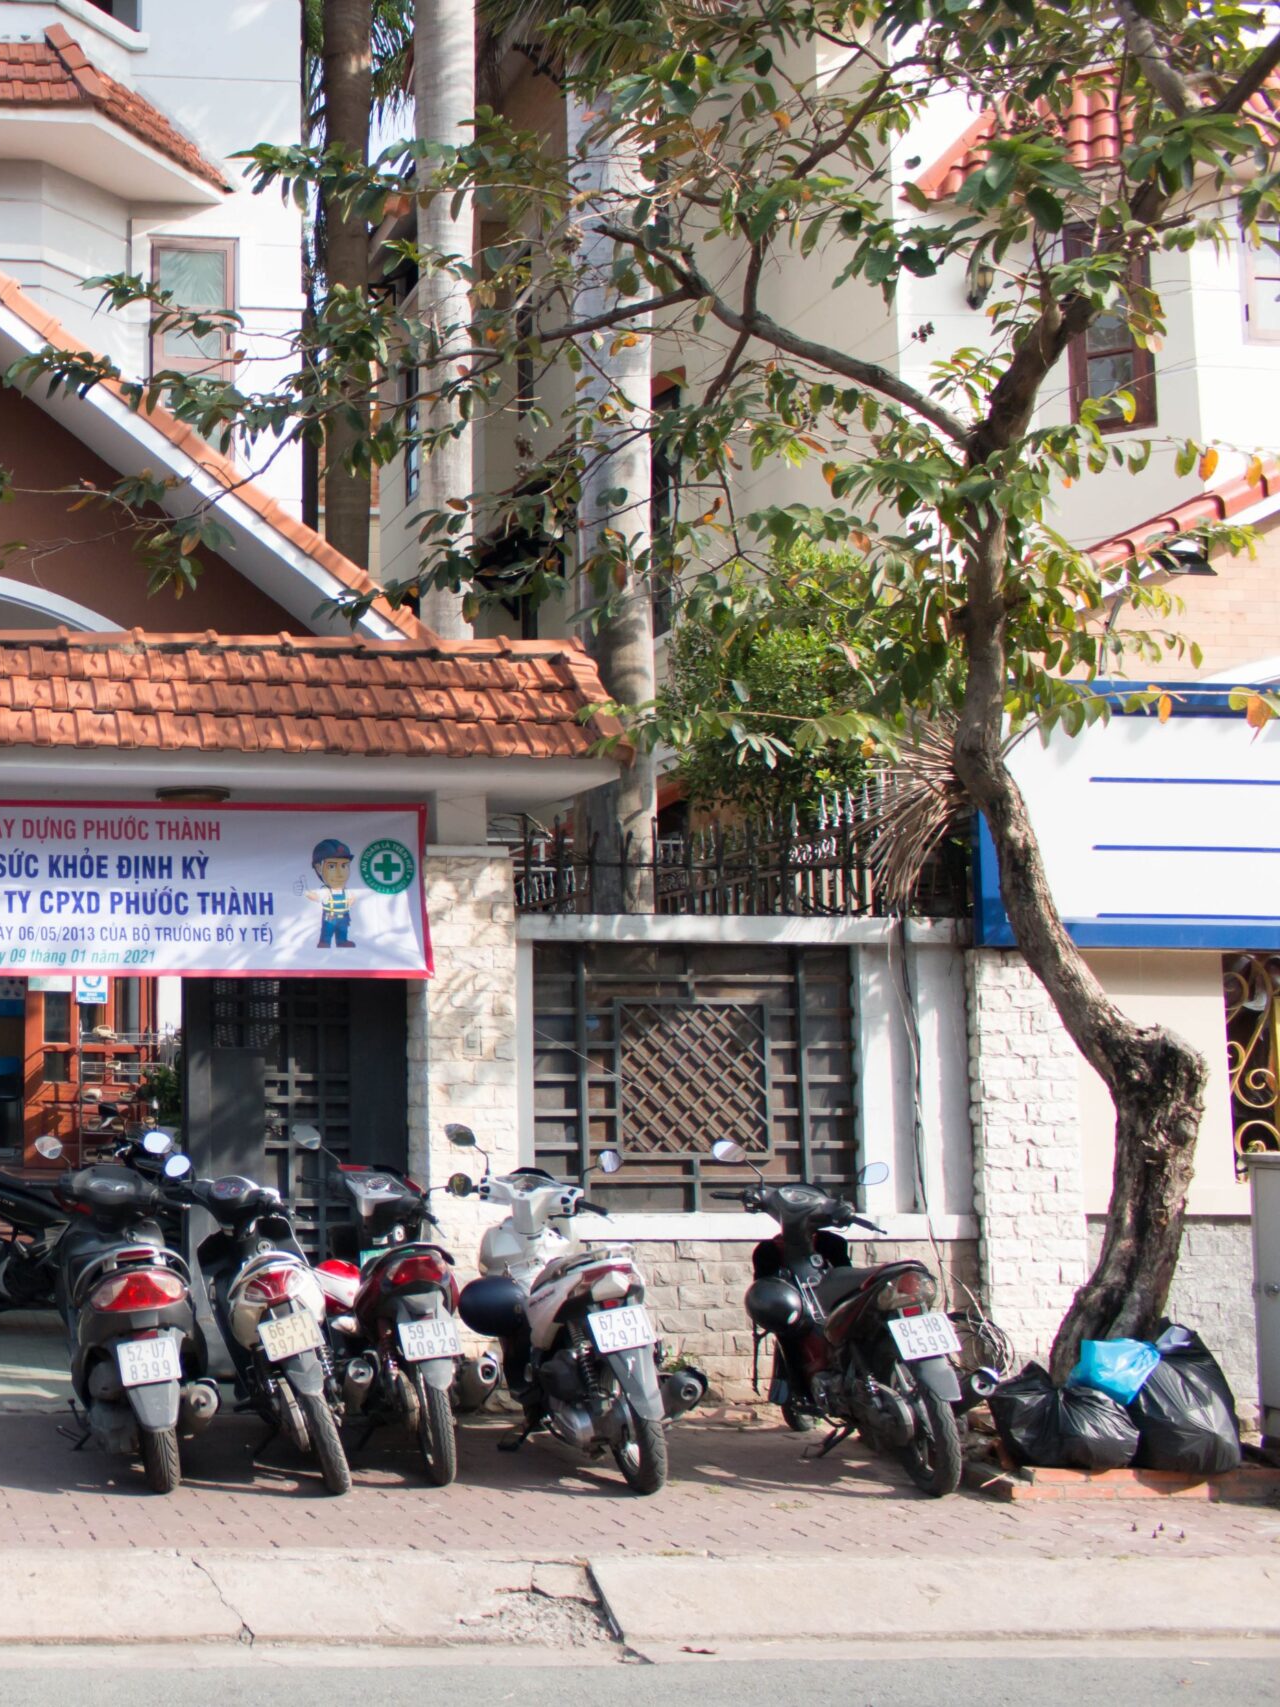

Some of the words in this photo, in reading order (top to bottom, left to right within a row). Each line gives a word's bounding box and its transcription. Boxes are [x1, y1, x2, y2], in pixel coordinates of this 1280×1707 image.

[22, 816, 77, 844] DỰNG
[83, 815, 150, 841] PHƯỚC
[155, 816, 221, 841] THÀNH
[48, 847, 109, 879] KHỎE
[116, 855, 173, 885] ĐỊNH
[182, 850, 210, 880] KỲ
[4, 890, 32, 914] TY
[39, 890, 100, 914] CPXD
[110, 886, 189, 916] PHƯỚC
[197, 886, 274, 916] THÀNH
[18, 926, 96, 943] 06/05/2013
[100, 923, 128, 942] CỦA
[132, 924, 151, 945] BỘ
[155, 923, 211, 942] TRƯỞNG
[216, 924, 235, 945] BỘ
[239, 927, 248, 942] Y
[252, 922, 274, 946] TẾ)
[10, 948, 27, 963] 09
[30, 948, 67, 966] tháng
[71, 949, 87, 963] 01
[91, 949, 119, 963] năm
[123, 949, 156, 964] 2021
[268, 1317, 308, 1340] 66-F1
[599, 1309, 638, 1330] 67-G1
[898, 1317, 942, 1338] 84-H8
[407, 1322, 447, 1341] 59-U1
[127, 1341, 168, 1362] 52-U7
[908, 1333, 950, 1355] 4599
[130, 1359, 171, 1381] 8399
